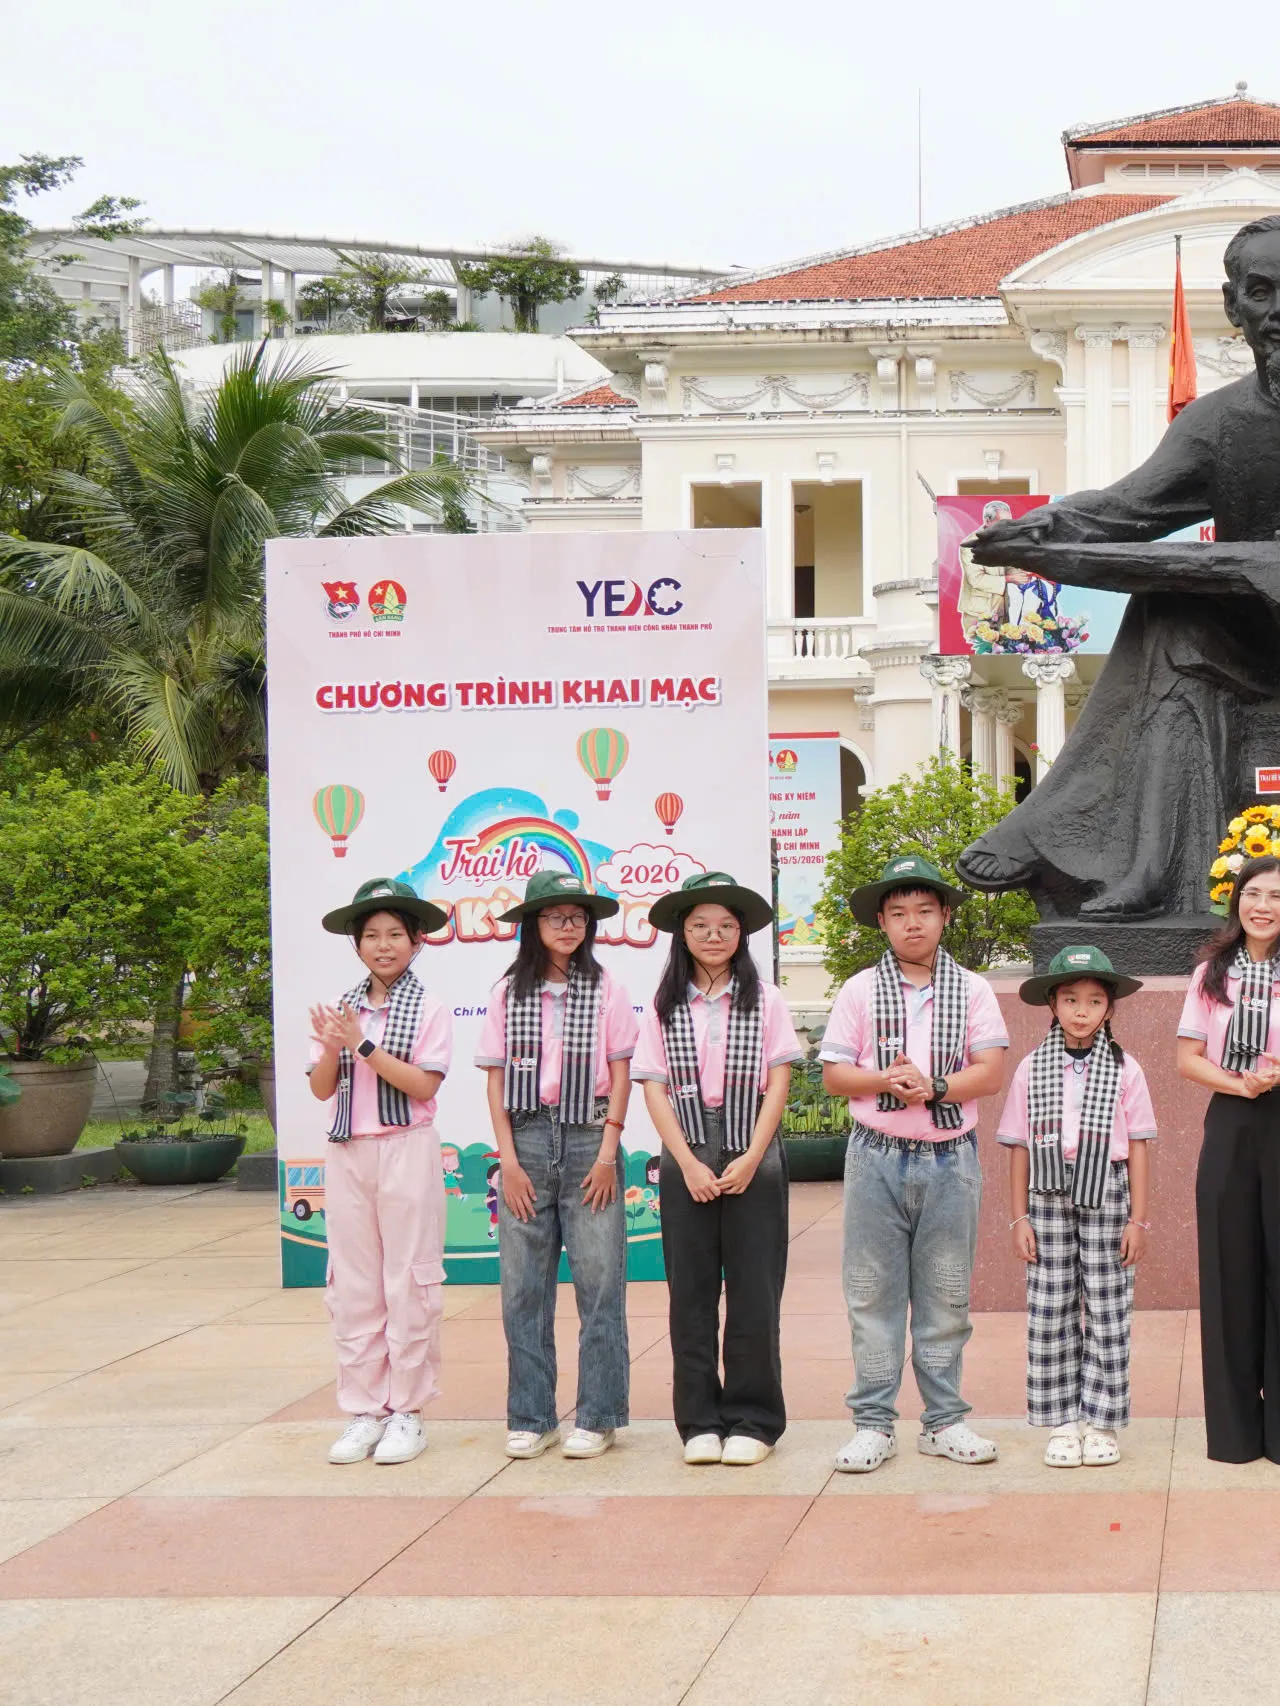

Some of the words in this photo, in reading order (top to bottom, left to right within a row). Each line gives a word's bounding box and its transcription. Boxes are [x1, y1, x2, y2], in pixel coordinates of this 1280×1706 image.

[315, 681, 447, 709] CHƯƠNG
[455, 676, 553, 706] TRÌNH
[562, 679, 640, 705] KHAI
[650, 677, 717, 708] MẠC
[799, 841, 820, 850] MINH
[440, 838, 503, 883] Trại
[505, 839, 540, 877] hè
[620, 857, 680, 884] 2026
[453, 1006, 475, 1017] Chí
